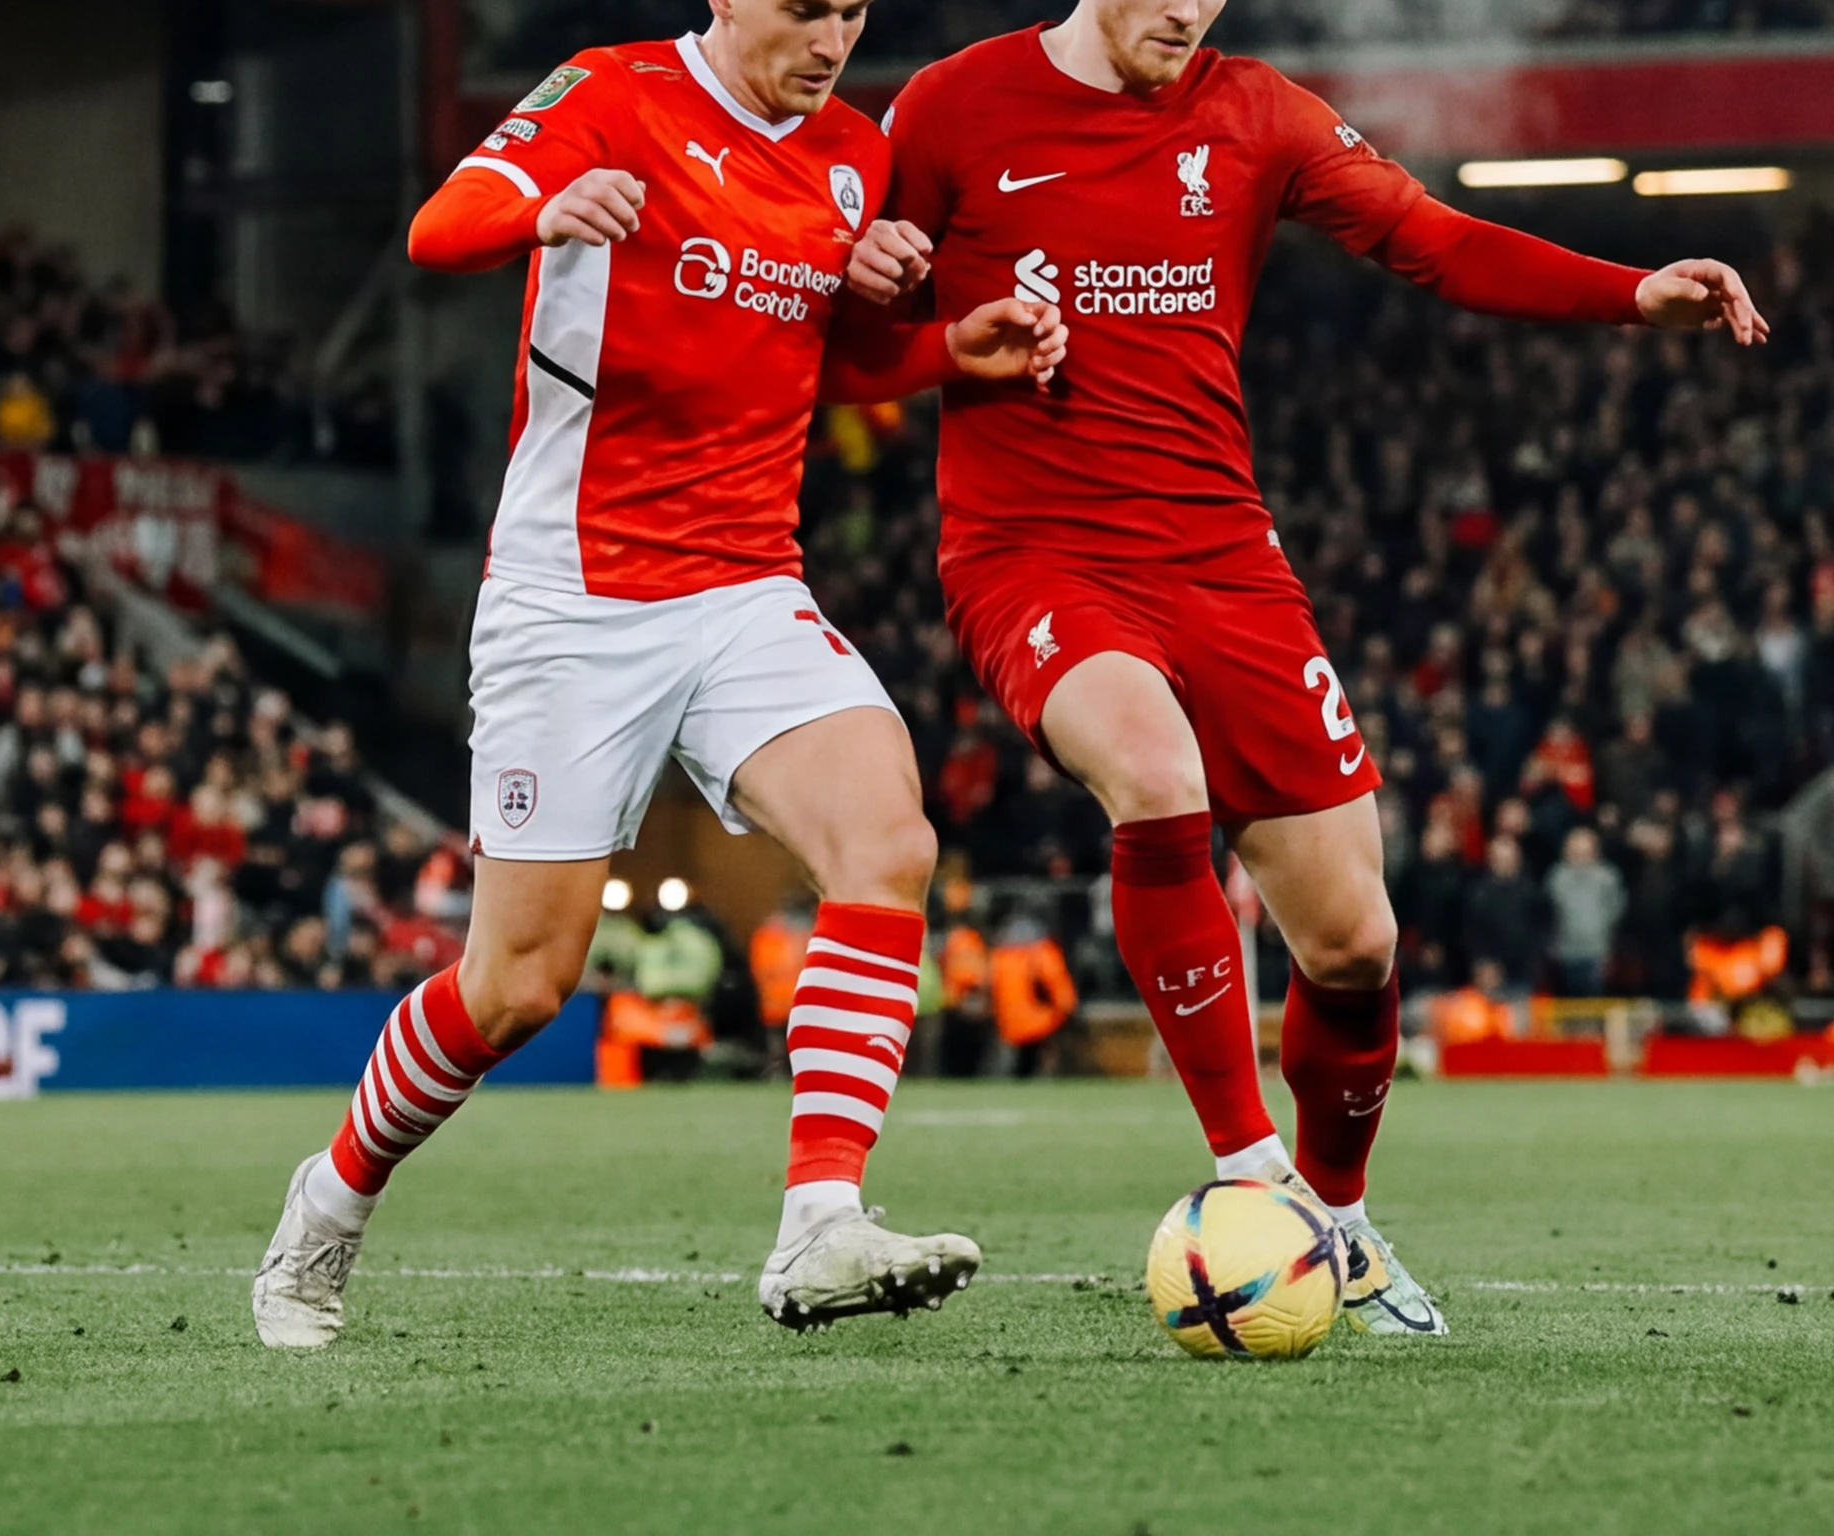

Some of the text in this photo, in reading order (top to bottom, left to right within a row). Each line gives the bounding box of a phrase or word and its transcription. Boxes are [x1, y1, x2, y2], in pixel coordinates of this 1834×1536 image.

[1074, 258, 1212, 287] standard
[1075, 285, 1215, 314] chartered
[1303, 655, 1356, 741] 2
